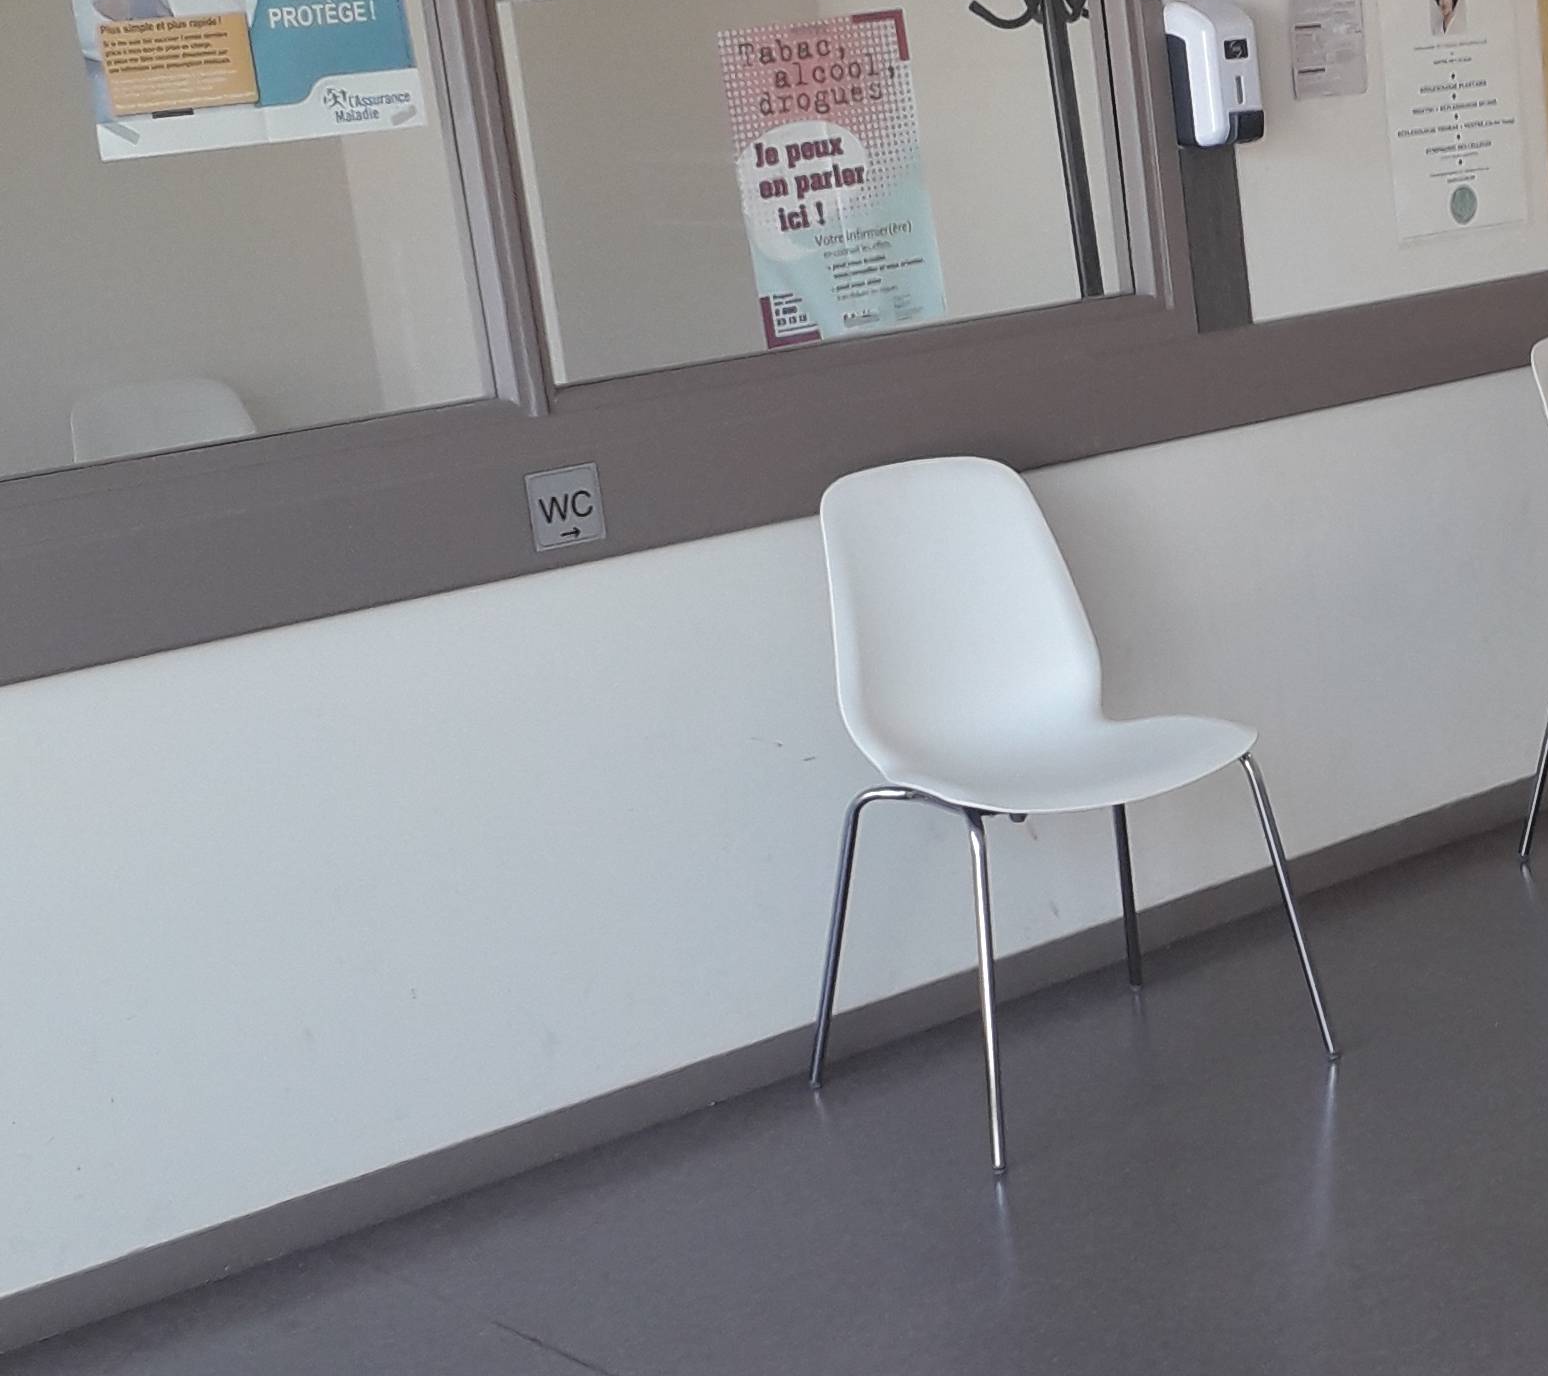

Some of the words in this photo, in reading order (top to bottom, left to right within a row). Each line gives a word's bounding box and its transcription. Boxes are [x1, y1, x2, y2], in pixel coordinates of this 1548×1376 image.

[738, 39, 845, 67] Tabac,
[775, 53, 895, 88] alcool,
[759, 82, 883, 116] drogues
[335, 108, 380, 123] Maladie
[754, 143, 779, 168] Je
[785, 137, 844, 169] peux
[759, 177, 789, 199] en
[794, 163, 865, 200] parler
[778, 204, 810, 232] ici
[816, 201, 826, 226] !
[815, 234, 844, 247] Votre
[538, 490, 594, 524] WC
